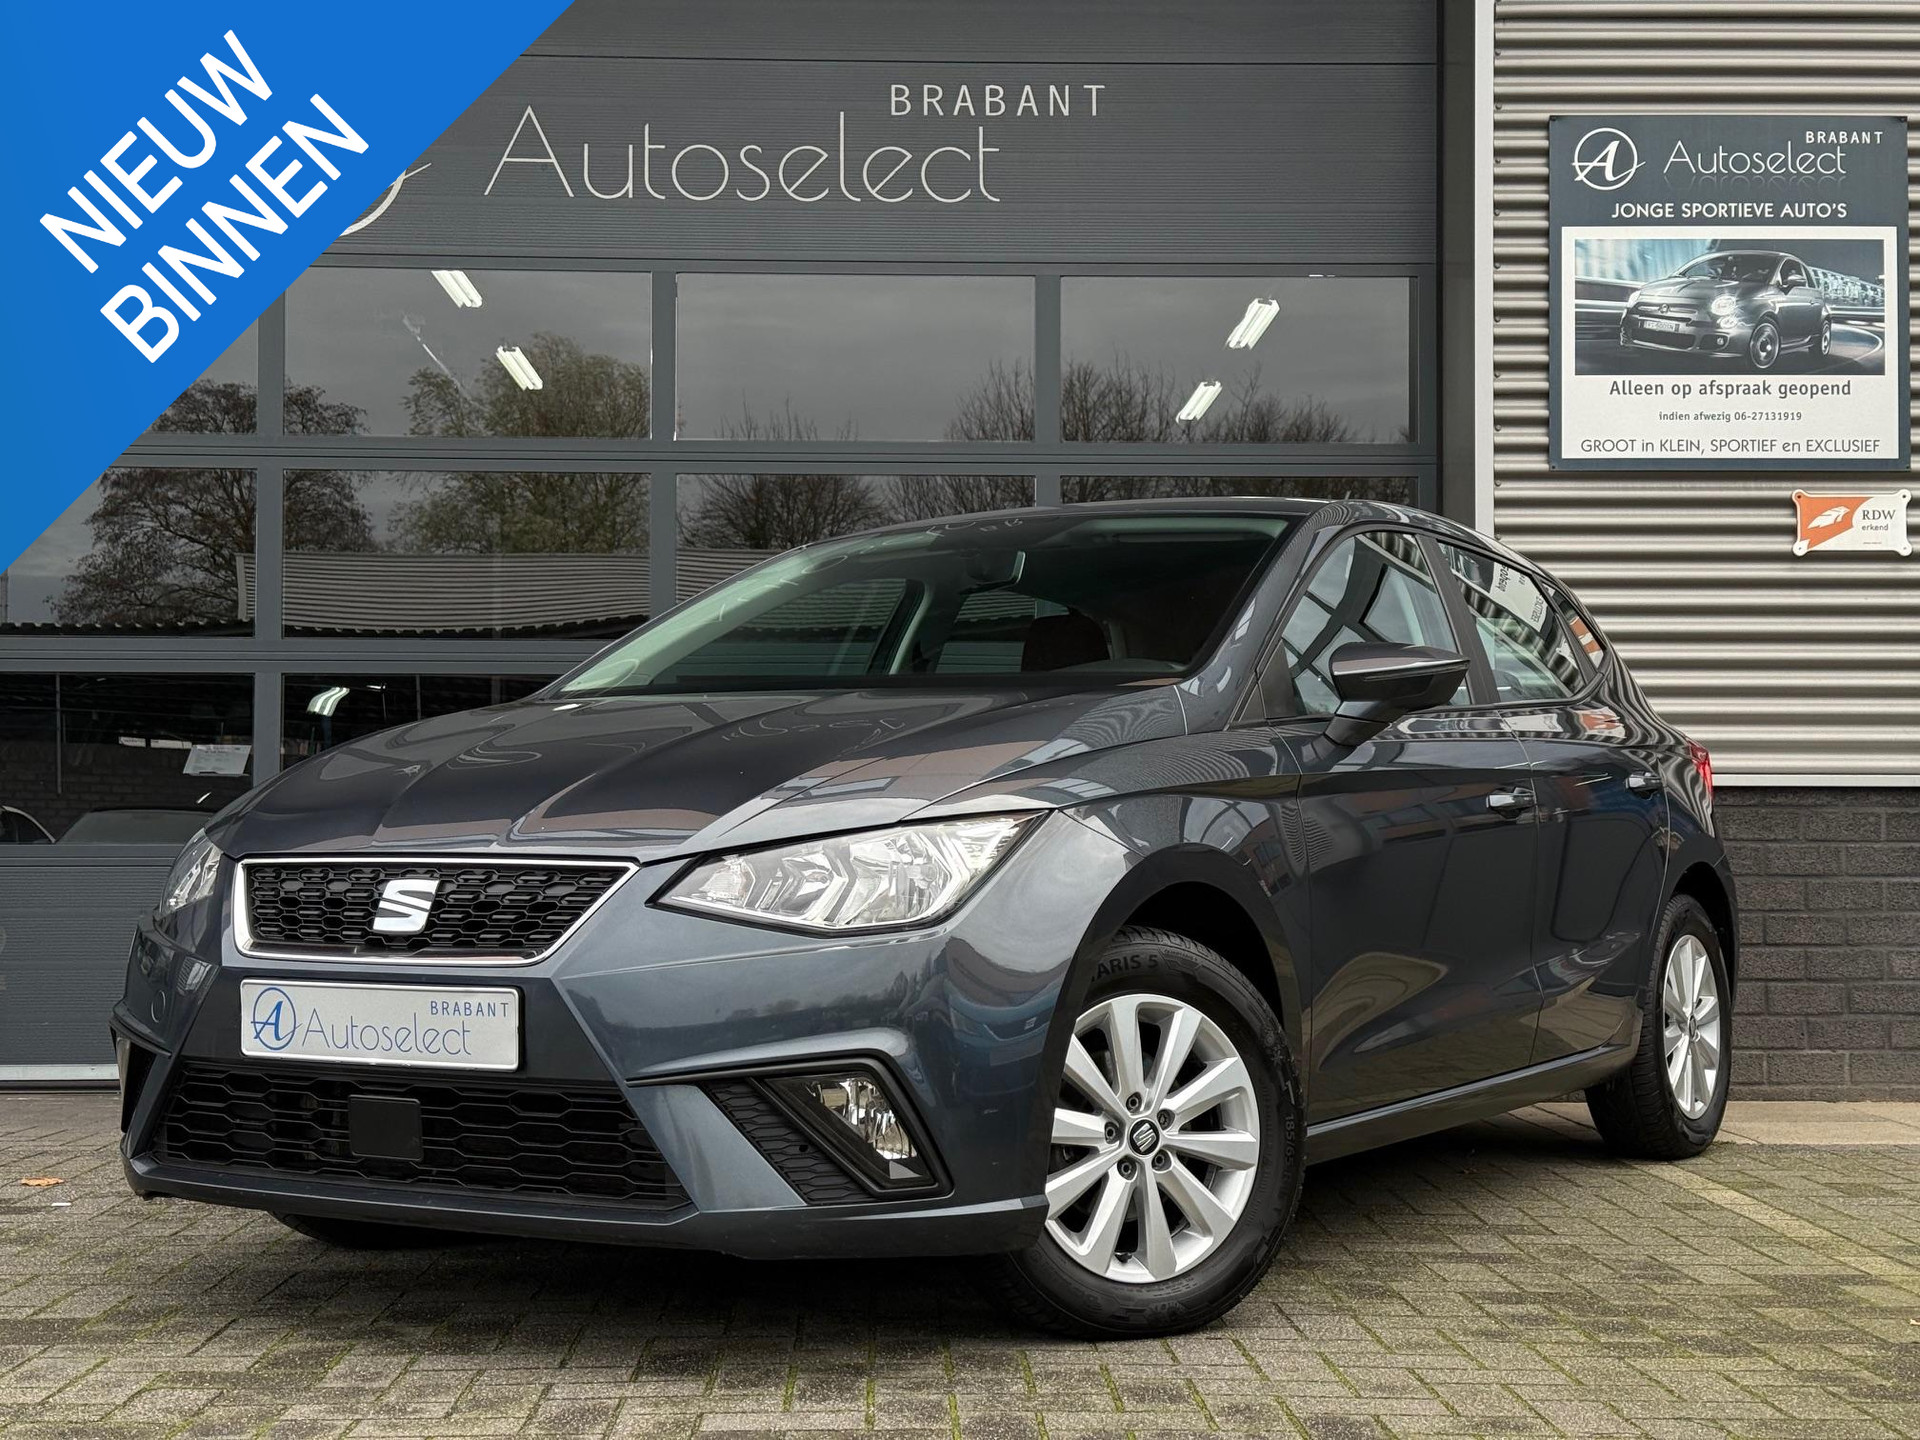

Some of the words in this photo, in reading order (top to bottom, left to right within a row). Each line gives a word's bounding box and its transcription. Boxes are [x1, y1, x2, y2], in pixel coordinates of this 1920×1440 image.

[891, 84, 1105, 117] BRABANT
[1805, 131, 1883, 144] BRABANT
[484, 105, 1001, 203] Autoselect
[1663, 140, 1847, 174] Autoselect
[1611, 202, 1675, 219] JONGE
[1681, 202, 1774, 218] SPORTIEVE
[1609, 380, 1664, 396] Alleen
[1670, 383, 1692, 400] op
[1698, 380, 1772, 400] afspraak
[1778, 380, 1851, 400] geopend
[1658, 411, 1690, 421] indien
[1693, 411, 1731, 424] afwezig
[1733, 411, 1802, 422] 06-27131919
[1580, 439, 1636, 453] GROOT
[1641, 440, 1655, 452] in
[1660, 439, 1705, 456] KLEIN,
[1710, 439, 1777, 453] SPORTIEF
[1782, 442, 1801, 453] en
[1806, 439, 1880, 453] EXCLUSIEF
[1862, 509, 1896, 521] RDW
[1861, 523, 1889, 531] erkend
[1147, 954, 1159, 969] 5
[430, 1000, 509, 1018] BRABANT
[302, 1008, 472, 1056] Autoselect
[1284, 1112, 1296, 1168] 185/65
